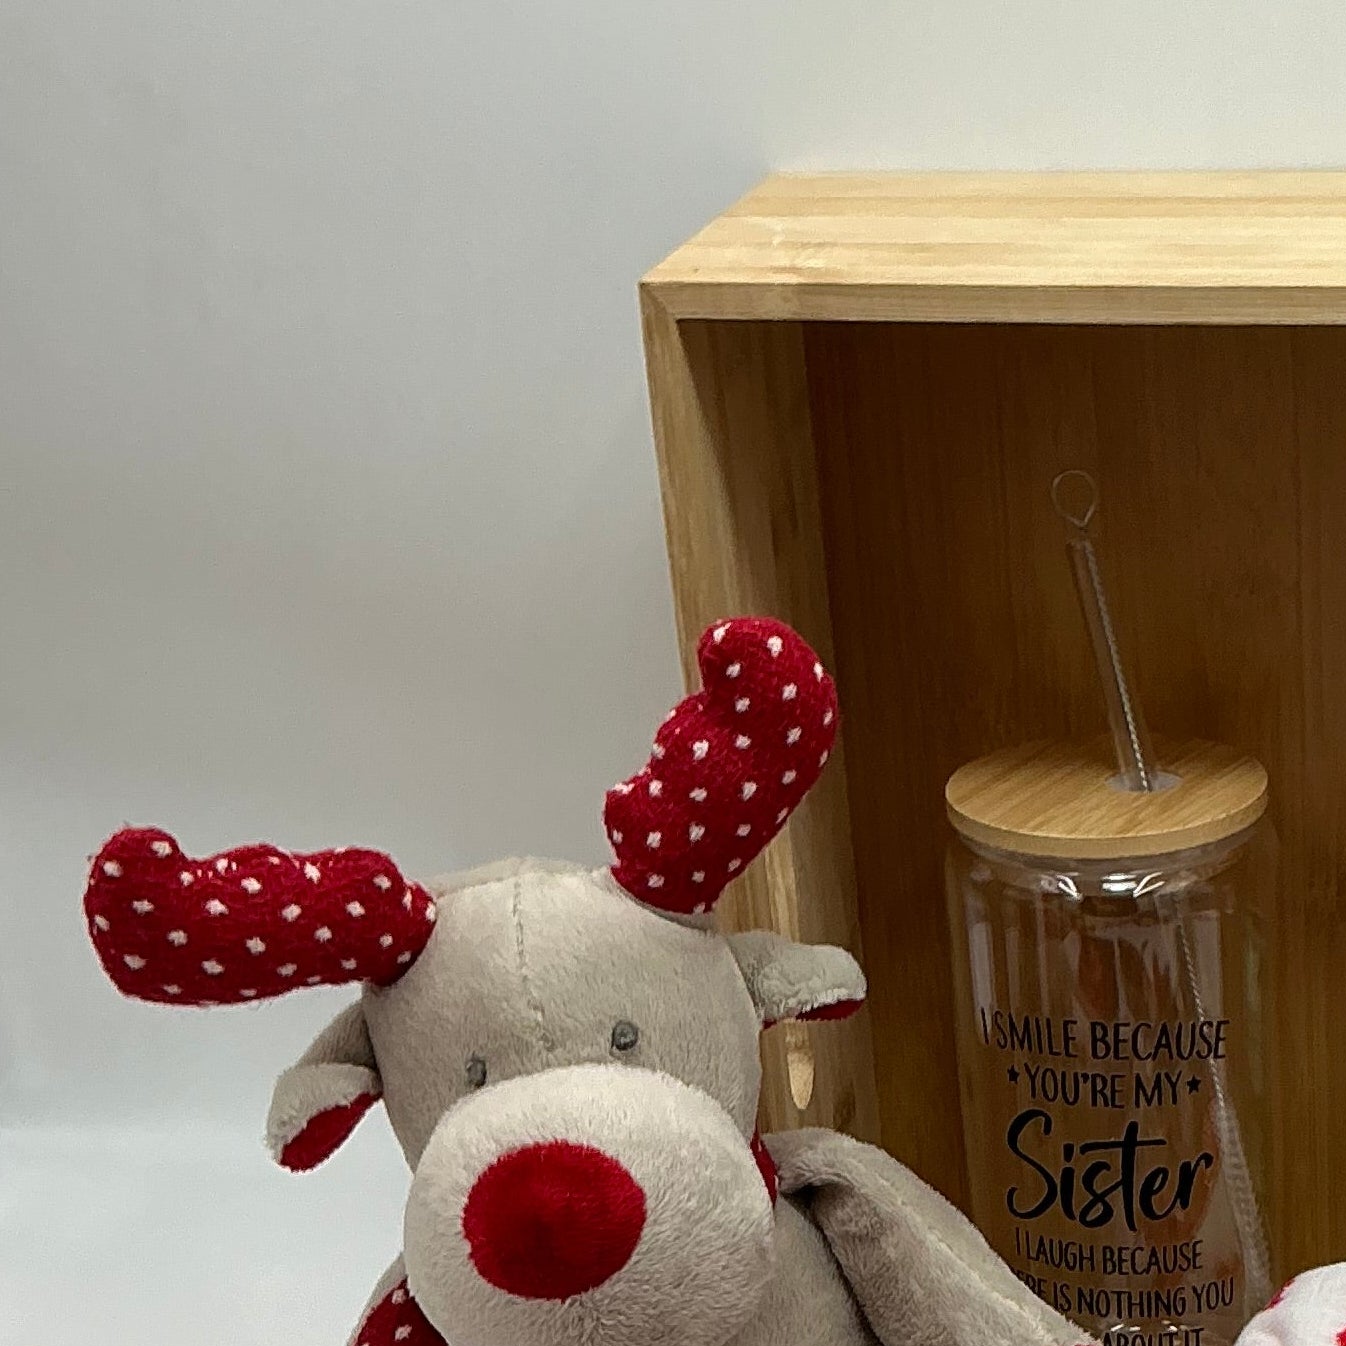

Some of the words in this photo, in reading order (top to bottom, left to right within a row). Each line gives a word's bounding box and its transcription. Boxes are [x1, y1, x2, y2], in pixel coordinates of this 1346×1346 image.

[981, 1006, 990, 1045] I
[992, 1010, 1078, 1059] SMILE
[1090, 1019, 1231, 1061] BECAUSE
[1023, 1062, 1125, 1109] YOU'RE
[1134, 1070, 1183, 1109] MY
[1006, 1108, 1214, 1232] Sister
[1015, 1227, 1021, 1256] I
[1025, 1231, 1095, 1272] LAUGH
[1102, 1240, 1204, 1276] BECAUSE
[1053, 1281, 1072, 1313] IS
[1077, 1286, 1186, 1320] NOTHING
[1191, 1276, 1234, 1313] YOU
